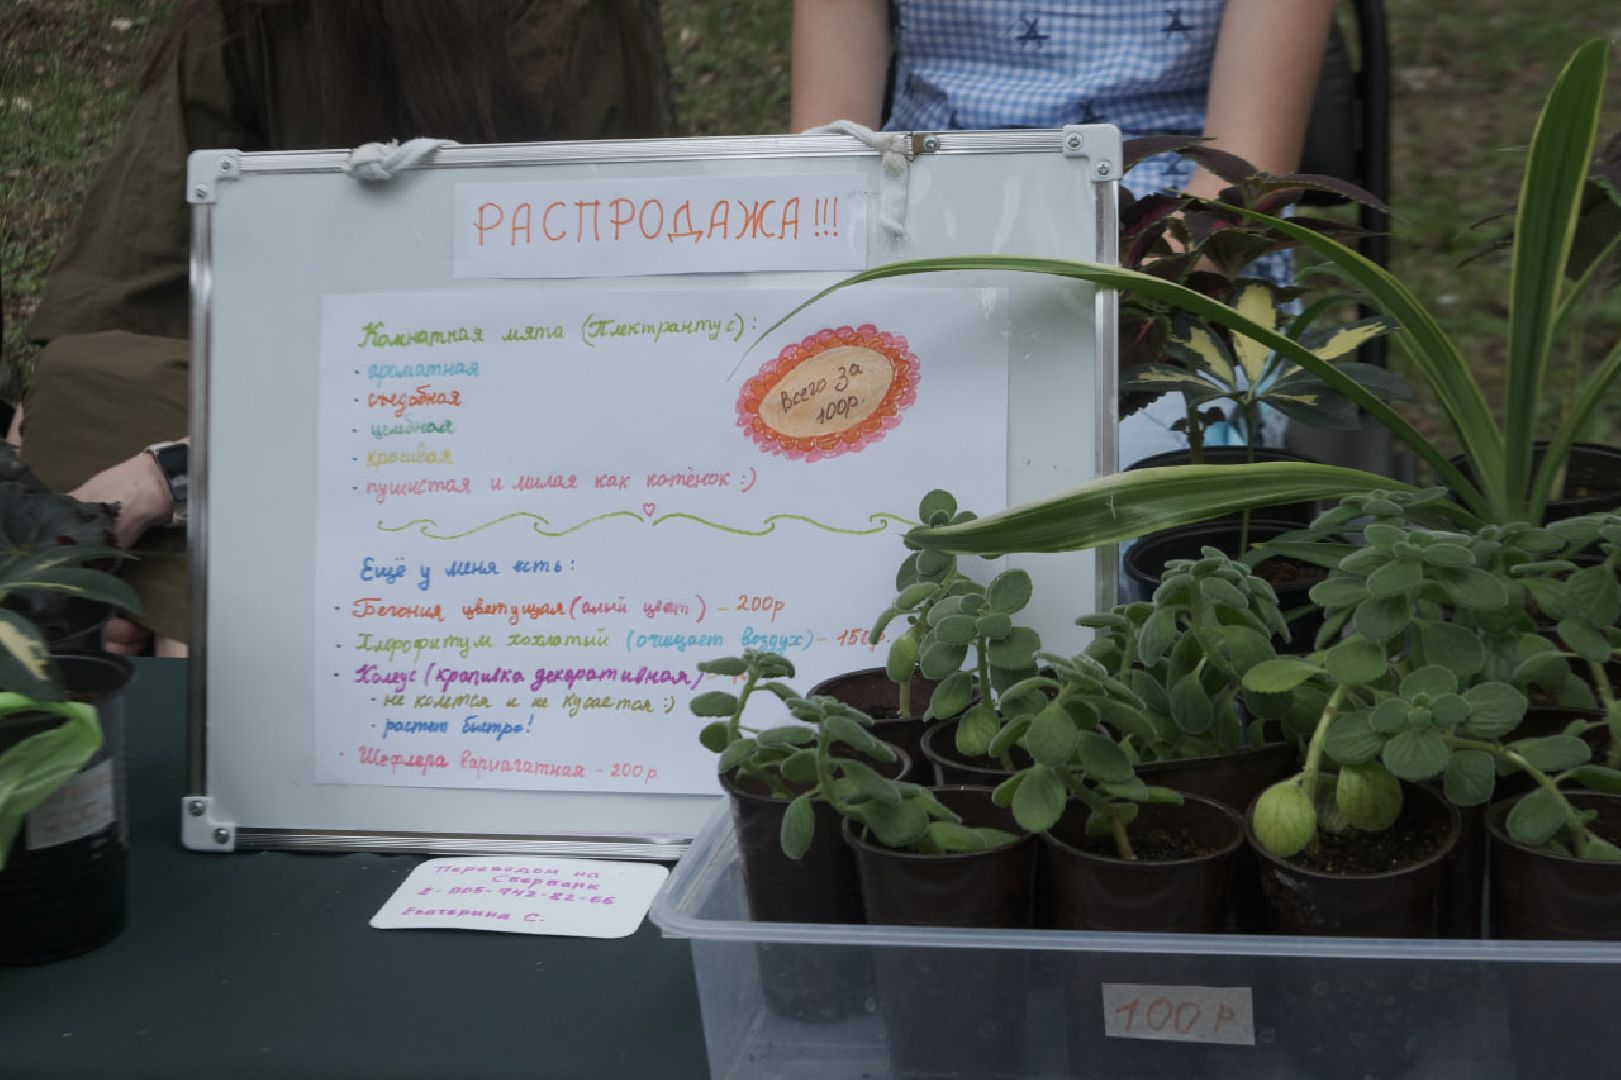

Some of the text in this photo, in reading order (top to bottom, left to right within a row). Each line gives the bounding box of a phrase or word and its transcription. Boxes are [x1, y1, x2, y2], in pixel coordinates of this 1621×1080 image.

[357, 320, 484, 348] Комнатная
[501, 326, 565, 342] мята
[367, 360, 481, 388] ароматная
[780, 377, 828, 415] Всего
[366, 441, 454, 472] красивая
[366, 475, 472, 503] пушистая
[490, 477, 503, 491] и
[511, 475, 578, 491] милая
[594, 473, 631, 489] как
[359, 556, 407, 585] Ещё
[417, 563, 430, 591] у
[444, 559, 500, 577] меня
[352, 597, 445, 622] Бегония
[506, 626, 609, 648] хохлатый
[354, 662, 417, 692] Колеус
[383, 694, 406, 707] не
[413, 693, 494, 710] колется
[505, 696, 521, 708] и
[530, 694, 550, 709] не
[561, 691, 655, 718] кусается
[358, 743, 449, 777] Шефлера
[400, 905, 511, 921] Екатерина
